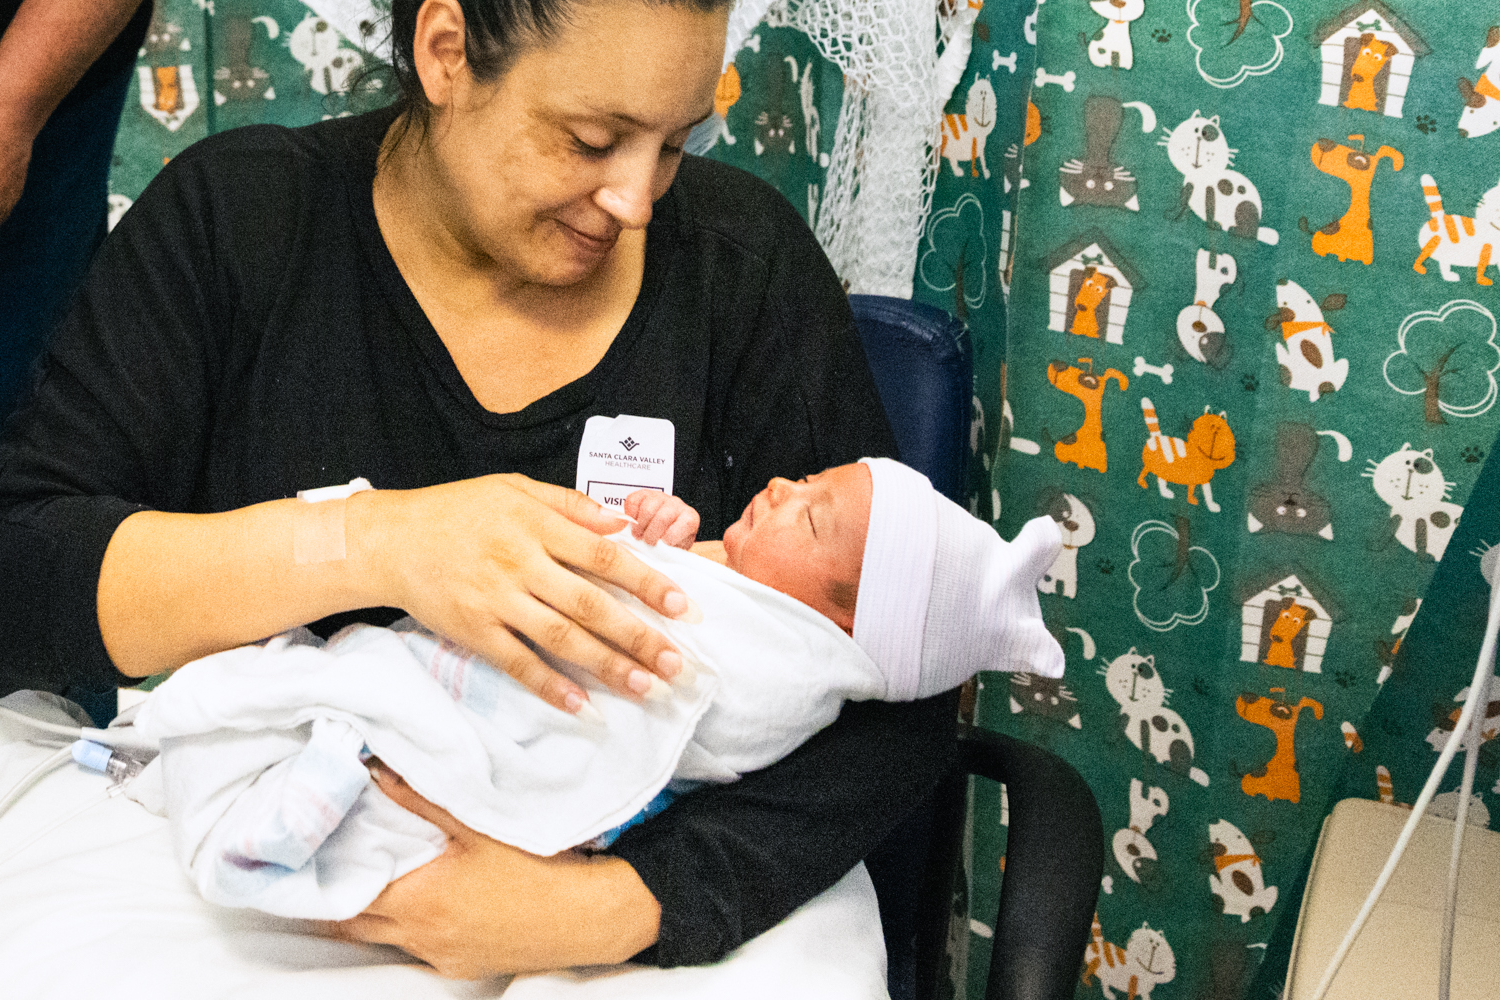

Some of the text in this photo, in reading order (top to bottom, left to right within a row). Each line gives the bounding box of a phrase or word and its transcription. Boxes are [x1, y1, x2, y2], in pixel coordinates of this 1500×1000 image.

[589, 451, 665, 464] SANTA CLARA VALLEY
[605, 461, 651, 470] HEALTHCARE
